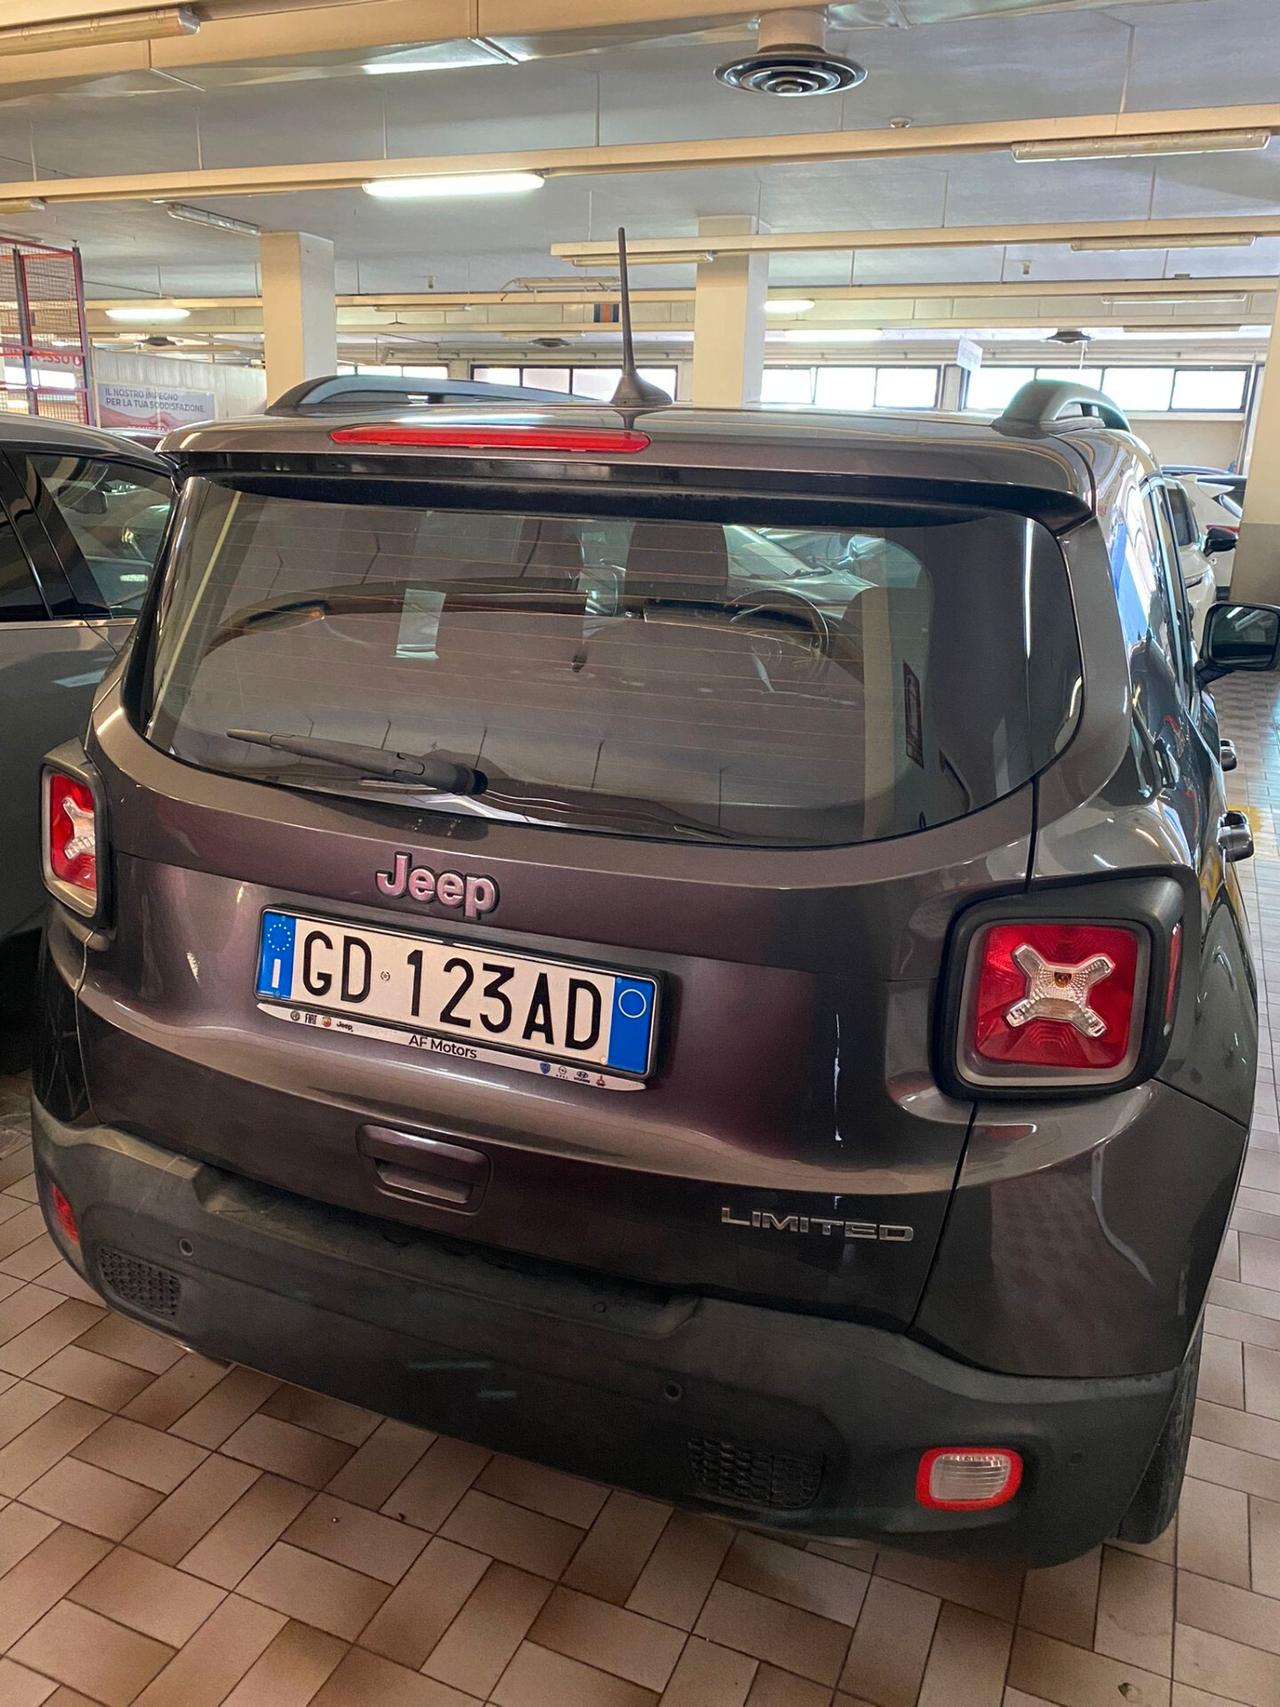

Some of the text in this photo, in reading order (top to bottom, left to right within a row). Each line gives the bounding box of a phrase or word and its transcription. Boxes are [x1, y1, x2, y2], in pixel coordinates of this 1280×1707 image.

[105, 388, 111, 396] IL
[113, 388, 144, 398] NOSTRO
[106, 397, 121, 407] PER
[123, 398, 133, 407] LA
[134, 399, 149, 408] TUA
[376, 851, 499, 920] Jeep
[409, 1034, 478, 1059] AF Motors
[721, 1207, 914, 1242] LIMITED
